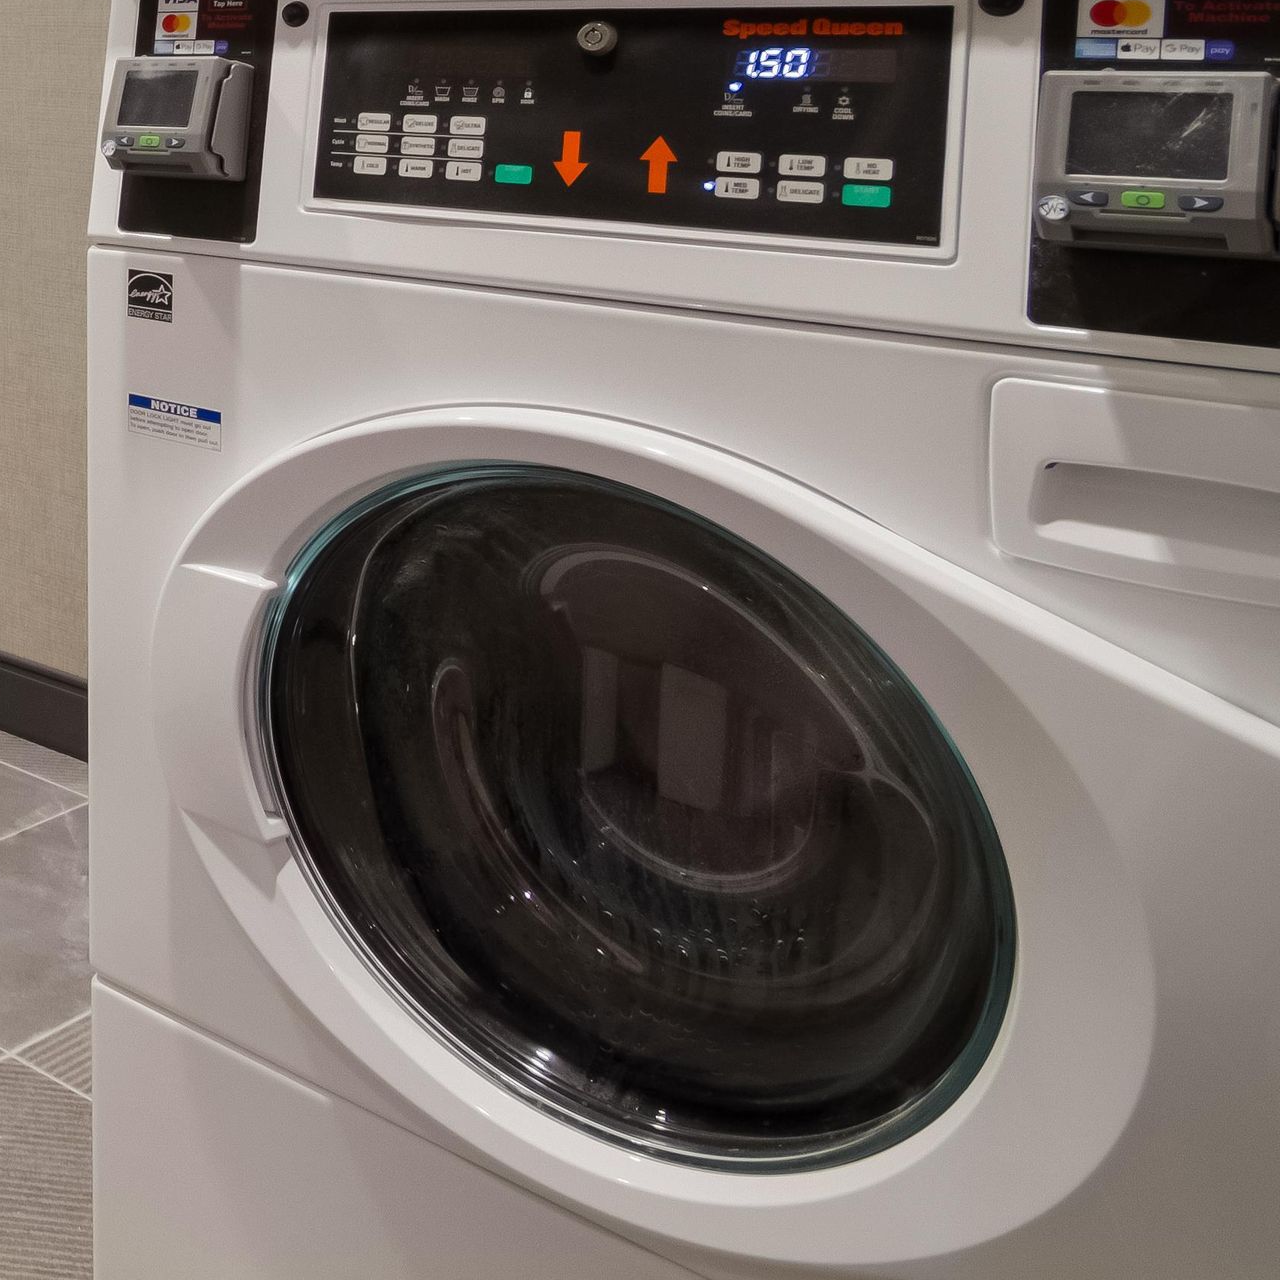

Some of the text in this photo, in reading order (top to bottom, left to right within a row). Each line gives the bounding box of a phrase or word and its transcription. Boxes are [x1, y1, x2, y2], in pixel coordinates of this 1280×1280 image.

[723, 18, 904, 39] Speed Queen
[1133, 43, 1156, 54] Pay
[1180, 44, 1200, 55] Pay
[1210, 47, 1231, 55] pay
[746, 48, 811, 78] 1.50
[128, 307, 172, 322] ENERGY STAR
[151, 400, 197, 418] NOTICE
